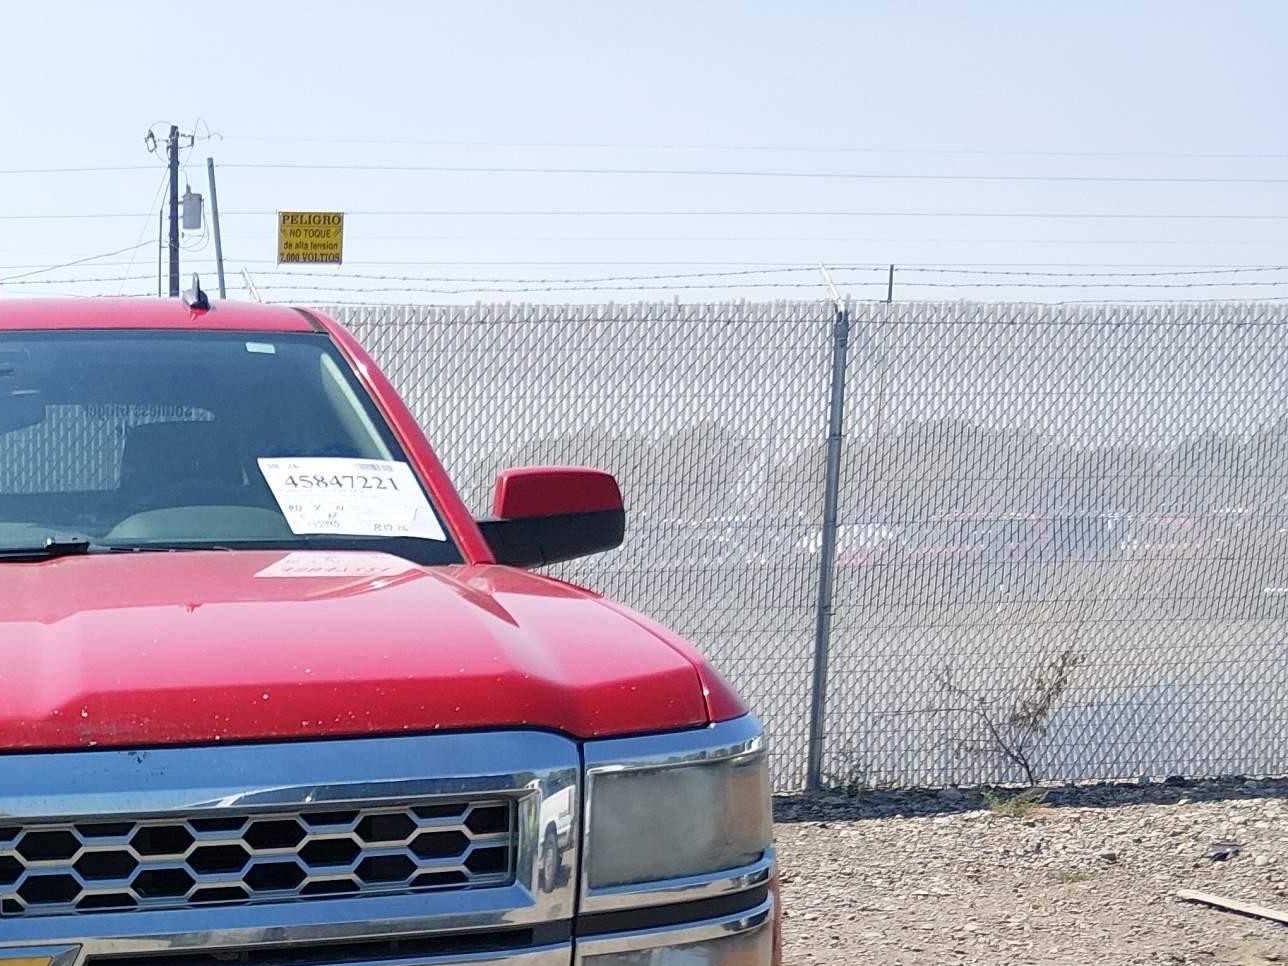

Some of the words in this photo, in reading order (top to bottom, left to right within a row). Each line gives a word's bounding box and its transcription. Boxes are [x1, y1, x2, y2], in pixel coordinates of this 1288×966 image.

[282, 214, 341, 225] PELIGRO
[289, 228, 302, 238] NO
[304, 228, 331, 239] TOQUE
[283, 241, 293, 250] de
[294, 241, 309, 250] alta
[310, 241, 338, 250] tension
[301, 253, 341, 263] VOLTIOS
[285, 474, 400, 491] 45847221
